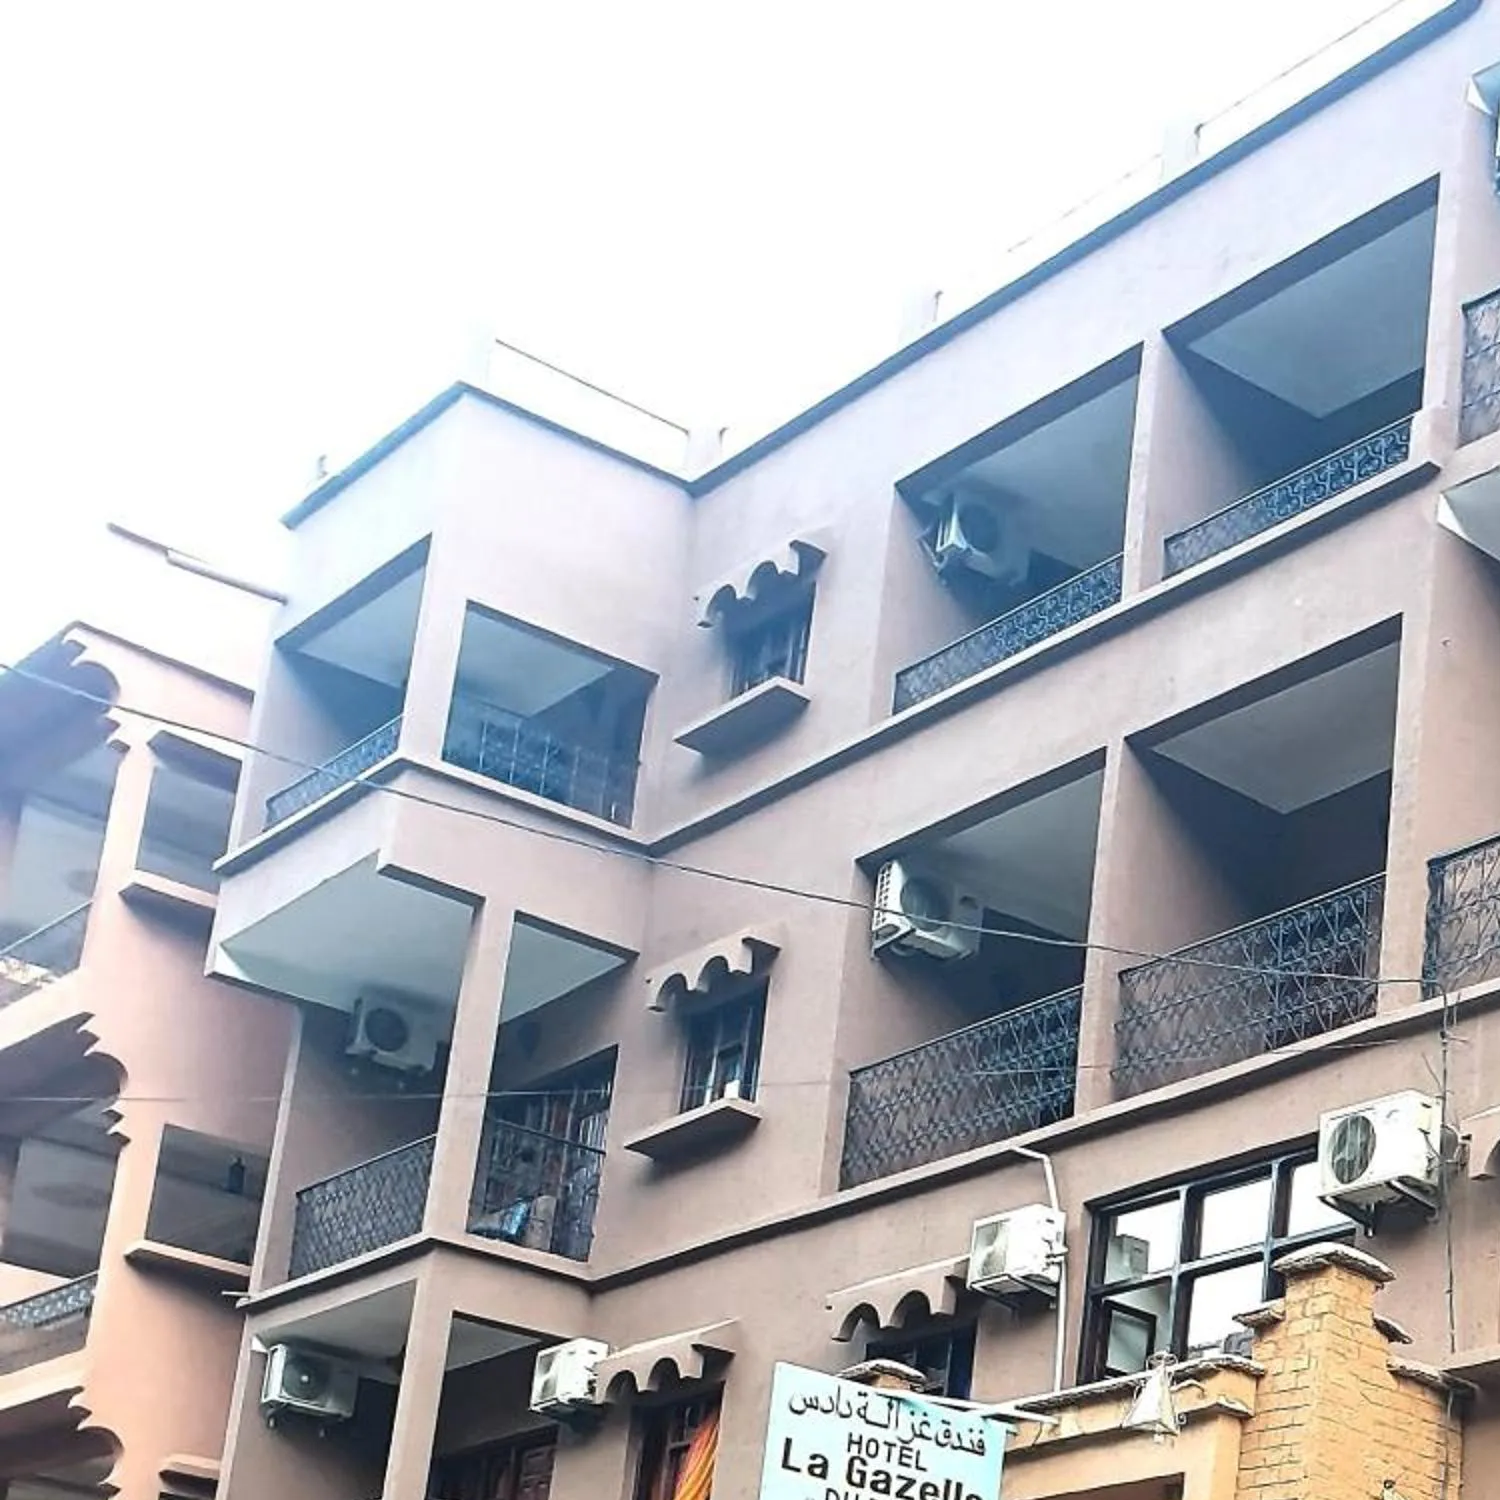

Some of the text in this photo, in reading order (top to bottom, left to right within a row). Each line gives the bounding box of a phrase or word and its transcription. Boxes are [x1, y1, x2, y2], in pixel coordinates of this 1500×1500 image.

[788, 1385, 853, 1418] دادس
[847, 1432, 928, 1472] HOTEL
[935, 1418, 986, 1457] فندق
[781, 1437, 830, 1480] La
